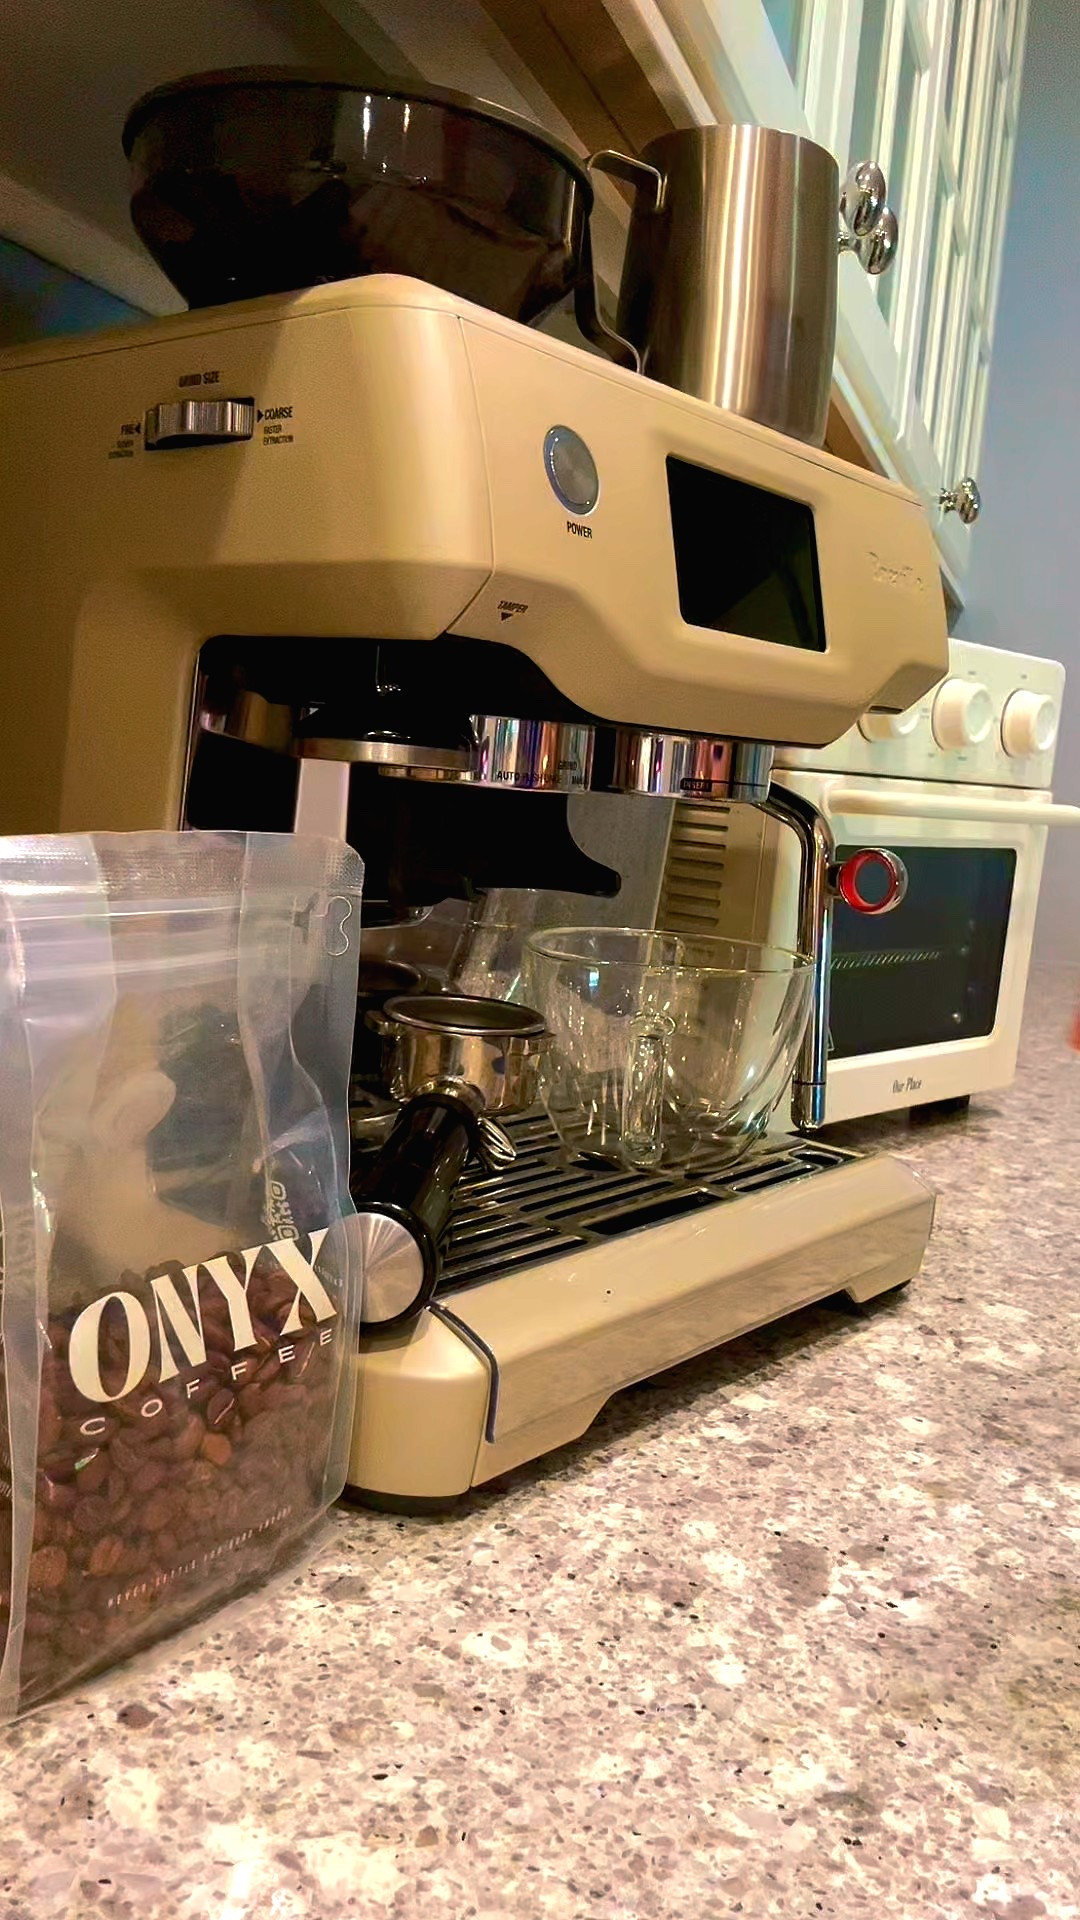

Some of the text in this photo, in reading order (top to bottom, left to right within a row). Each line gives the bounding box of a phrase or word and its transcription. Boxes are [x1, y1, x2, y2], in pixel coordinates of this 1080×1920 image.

[203, 371, 220, 384] SIZE
[264, 406, 293, 420] COARSE
[566, 521, 593, 538] POWER
[498, 601, 528, 613] TAMPER
[497, 771, 520, 782] AUTO
[69, 1228, 337, 1402] ONYX
[79, 1328, 333, 1436] COFFEE
